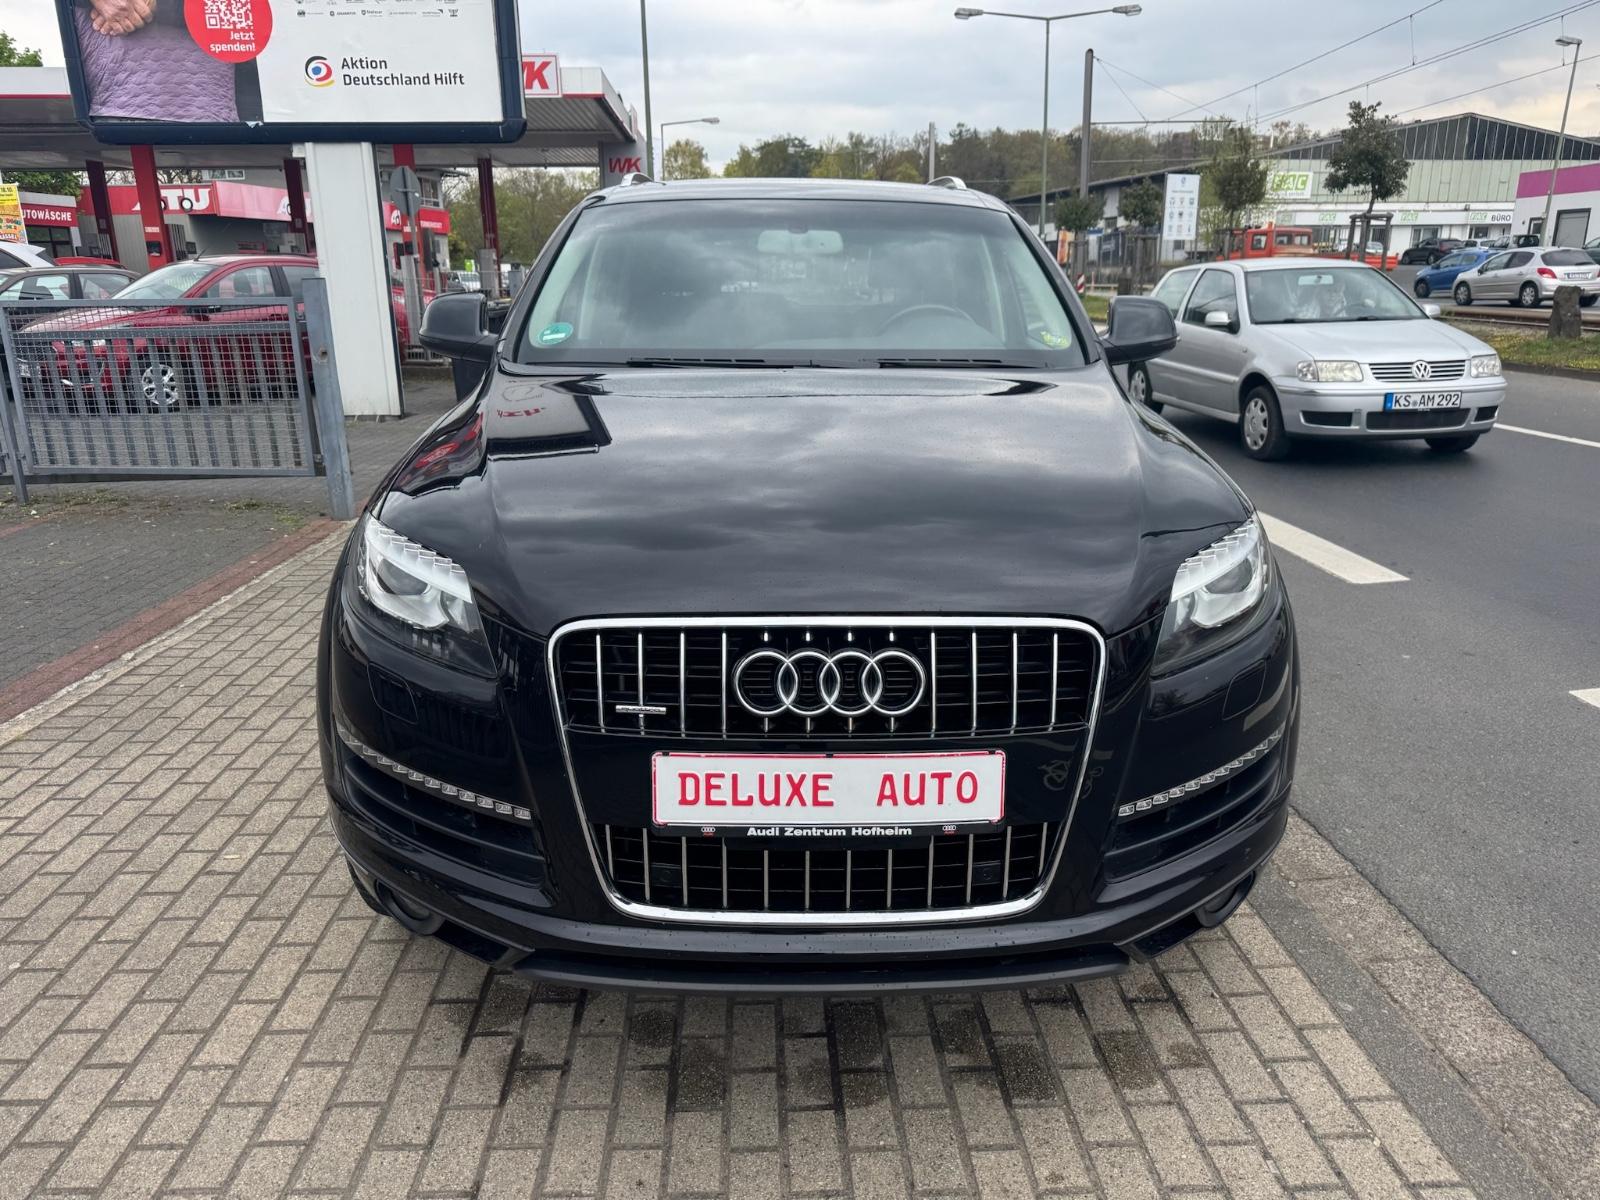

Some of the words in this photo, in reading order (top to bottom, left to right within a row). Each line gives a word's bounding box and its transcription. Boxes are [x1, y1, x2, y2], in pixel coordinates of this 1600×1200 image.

[230, 31, 255, 41] Jetzt
[209, 42, 256, 54] spenden!
[341, 57, 388, 70] Aktion
[343, 73, 431, 86] Deutschland
[434, 72, 465, 86] Hilft
[522, 61, 552, 90] K
[608, 157, 641, 173] WK
[22, 209, 73, 221] UTOWÄSCHE
[1491, 213, 1511, 222] BÜRO
[1437, 393, 1460, 407] 292
[678, 772, 835, 807] DELUXE
[876, 771, 979, 807] AUTO
[747, 827, 780, 837] Audi
[784, 827, 846, 837] Zentrum
[851, 826, 912, 837] Hofheim
